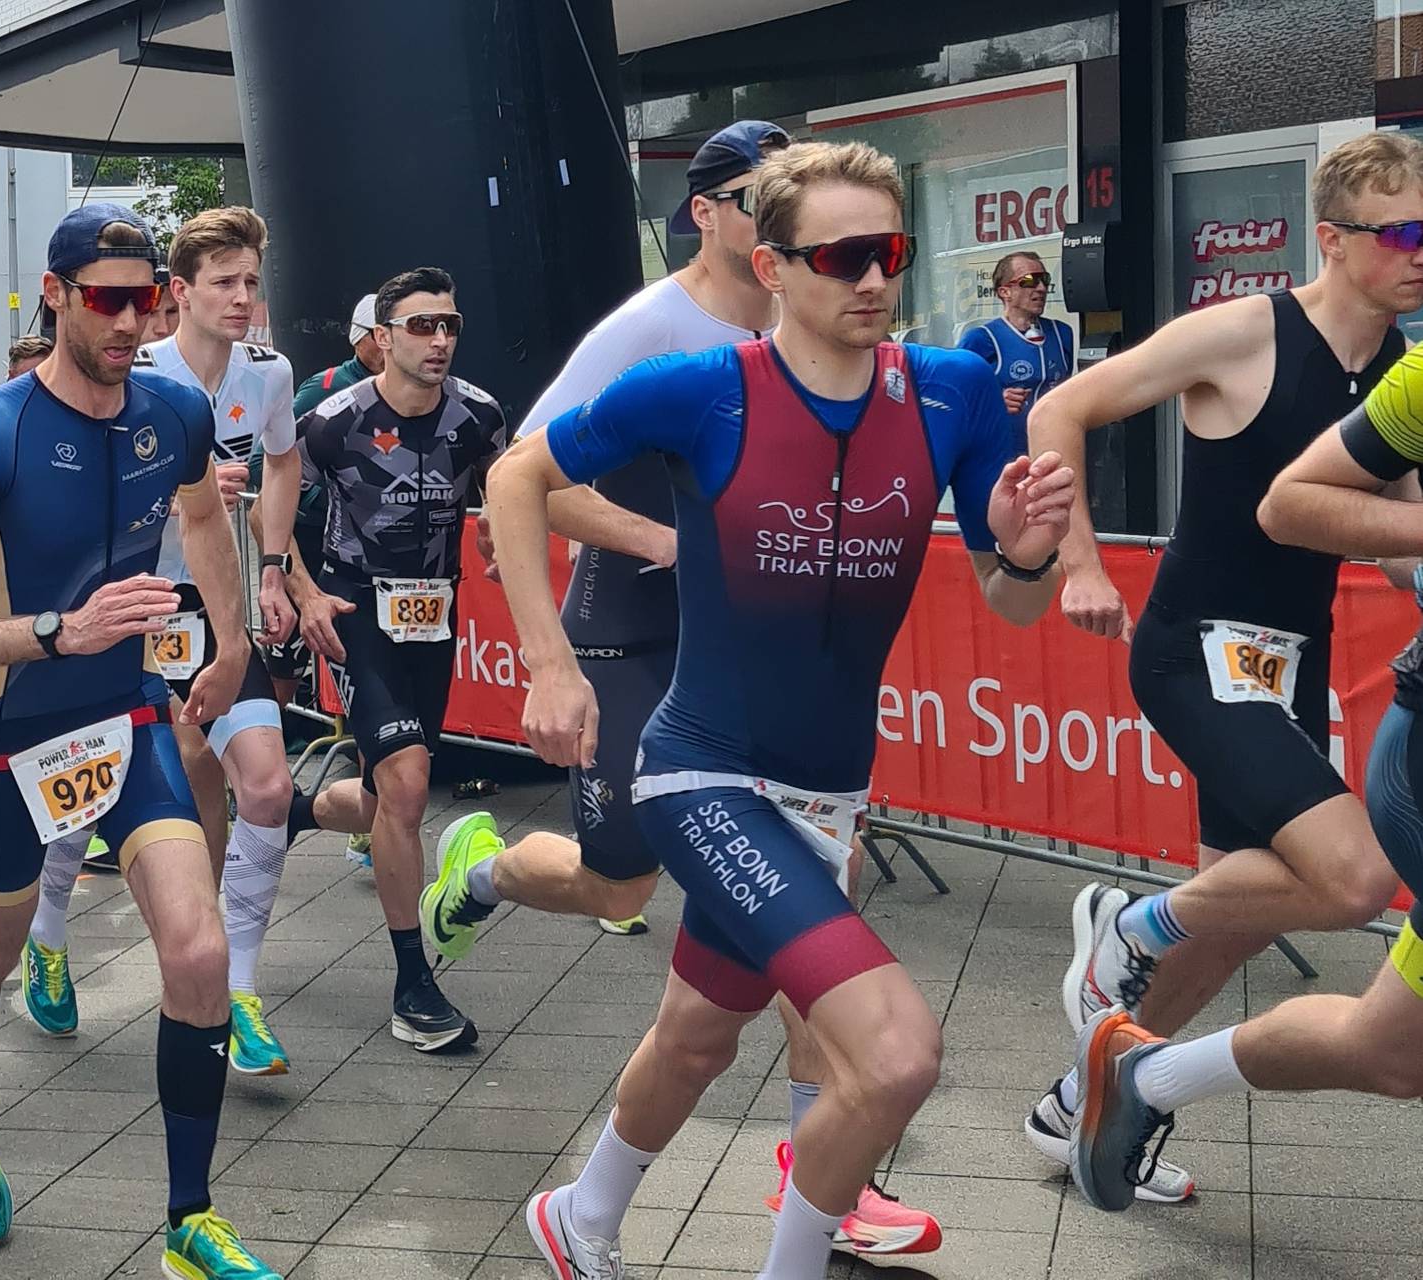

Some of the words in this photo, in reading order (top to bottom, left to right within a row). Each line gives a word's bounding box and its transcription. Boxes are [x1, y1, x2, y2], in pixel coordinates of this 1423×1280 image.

[1086, 167, 1114, 208] 15
[1063, 237, 1080, 248] Ergo
[1082, 235, 1102, 245] Wirtz
[1193, 219, 1287, 260] fair
[381, 488, 454, 505] NOWAK
[756, 529, 810, 553] SSF
[818, 537, 904, 557] BONN
[755, 553, 897, 578] TRIATHLON
[397, 599, 440, 623] 883
[967, 677, 1184, 789] Sport.
[37, 749, 70, 770] POWER
[85, 736, 107, 751] MAN
[52, 761, 114, 811] 920
[678, 813, 764, 915] TRIATHLON
[698, 801, 739, 836] SSF
[725, 835, 790, 898] BONN
